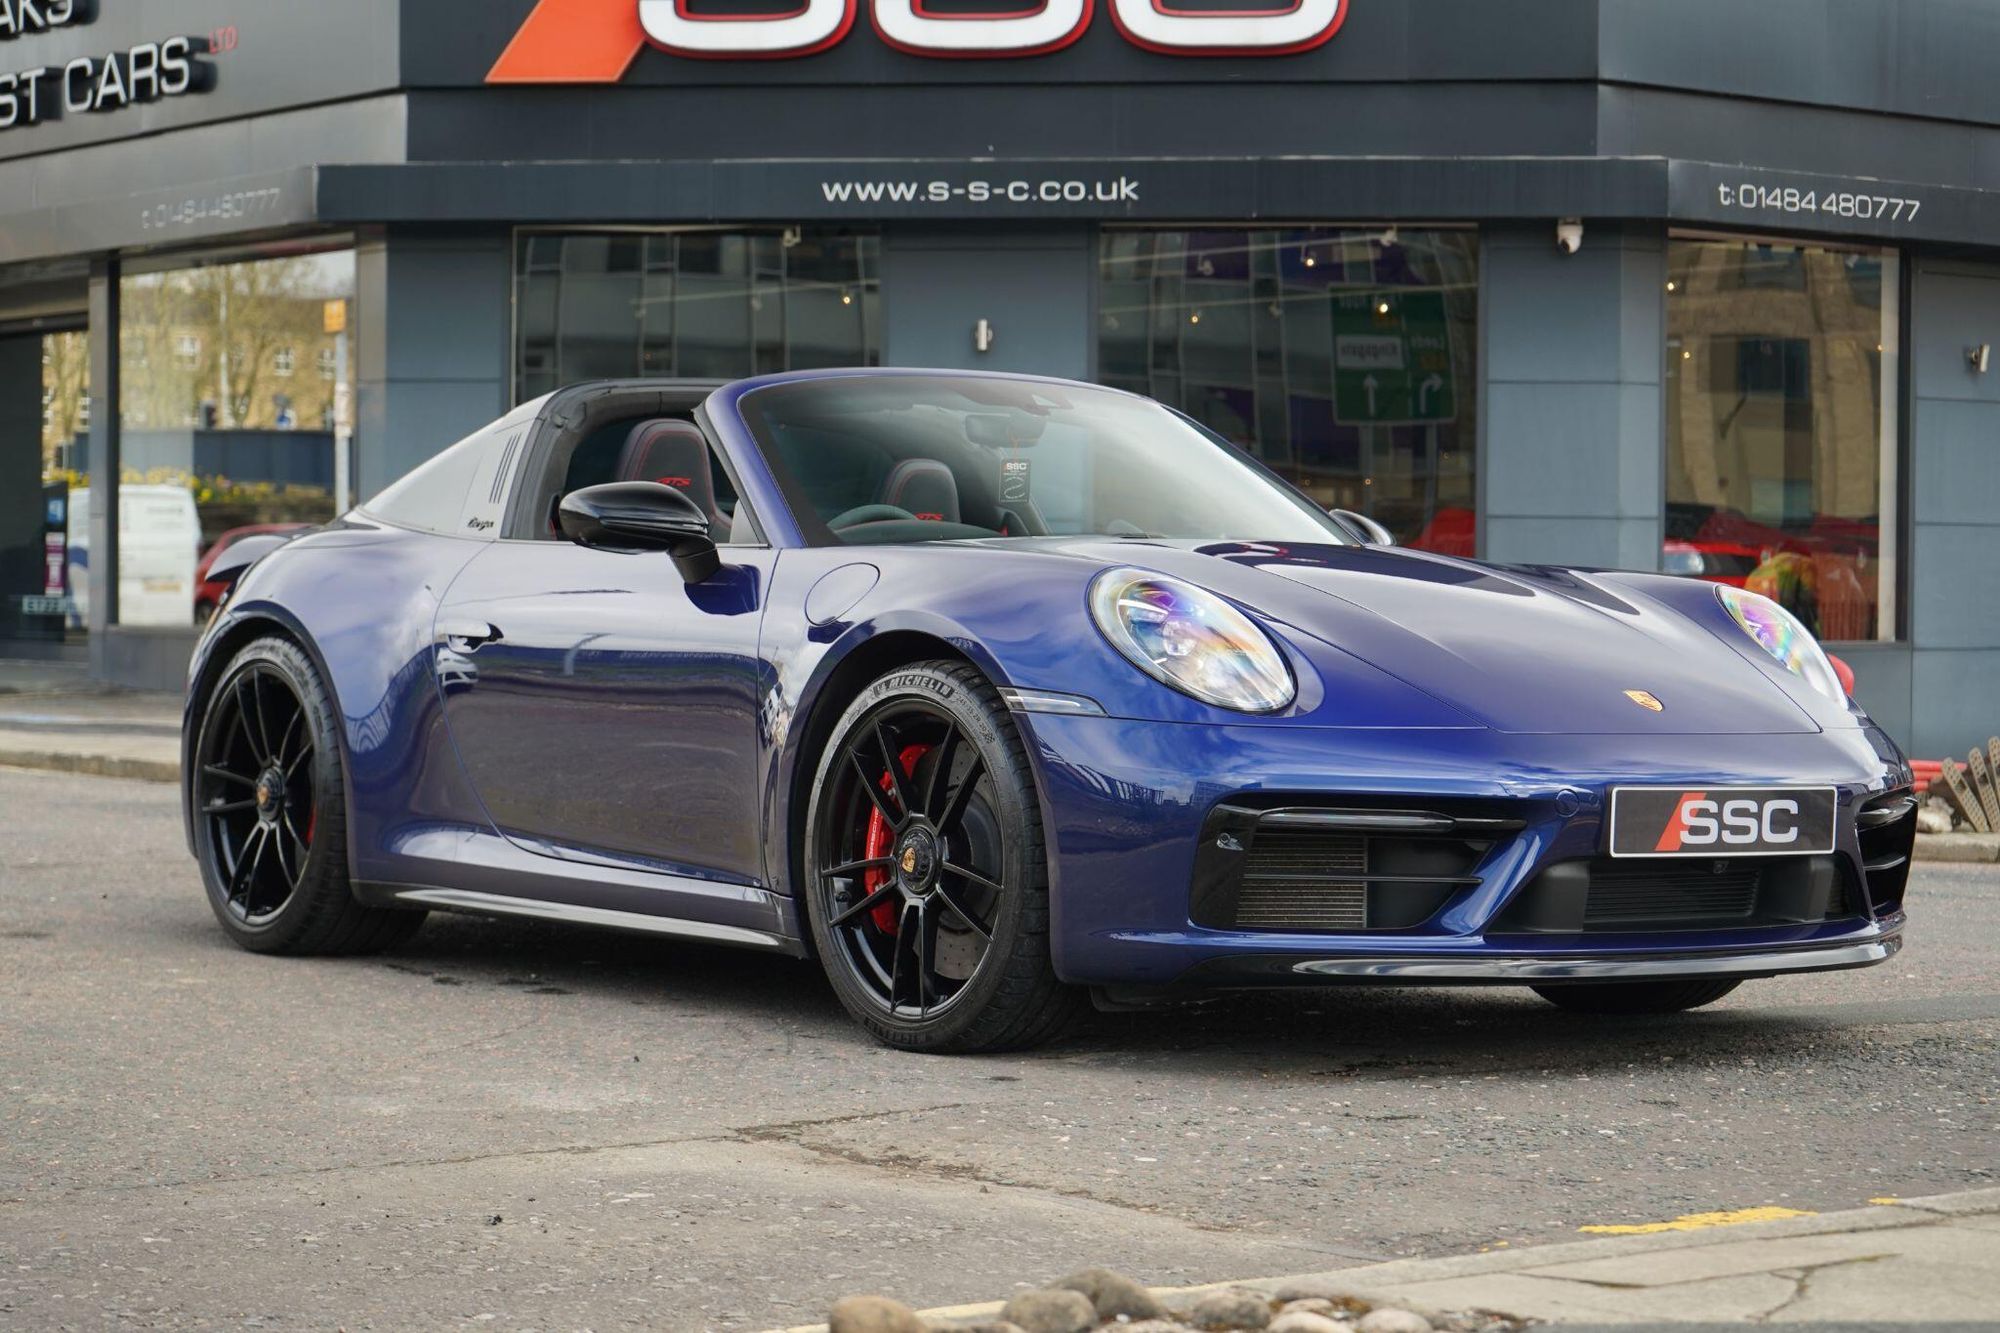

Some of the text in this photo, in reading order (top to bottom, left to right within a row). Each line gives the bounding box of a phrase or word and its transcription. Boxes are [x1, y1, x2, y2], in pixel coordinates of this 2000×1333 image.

[64, 36, 190, 113] CARS
[209, 26, 238, 56] LTD
[821, 176, 1140, 202] www.s-s-c.co.uk
[1739, 184, 1817, 213] 01484
[1821, 193, 1921, 222] 480777
[889, 675, 952, 697] MICHELIN
[1679, 799, 1799, 845] SSC
